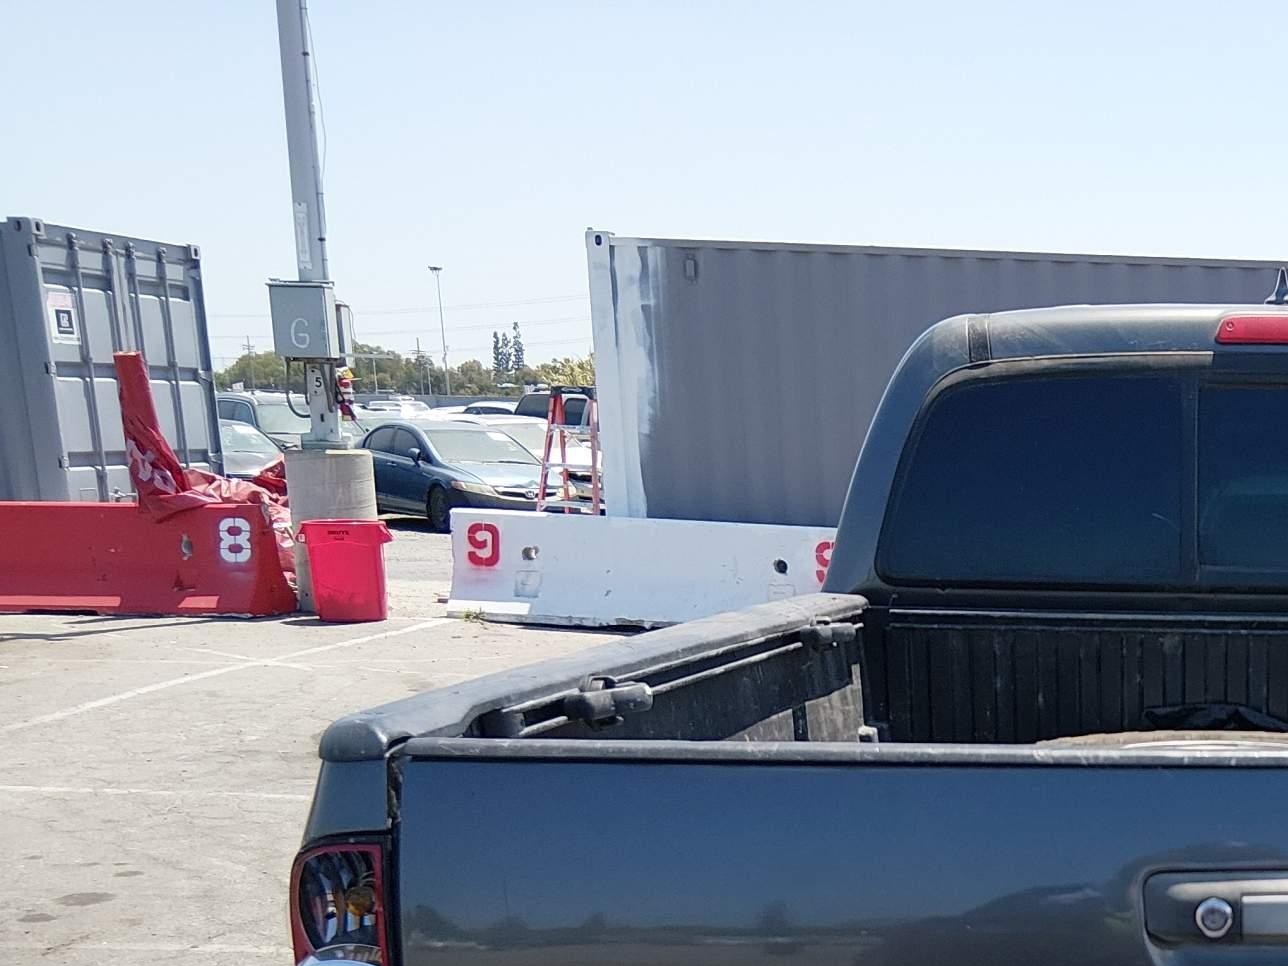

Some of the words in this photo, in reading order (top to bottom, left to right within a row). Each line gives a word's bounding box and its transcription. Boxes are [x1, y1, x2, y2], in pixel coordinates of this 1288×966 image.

[290, 318, 310, 349] G
[314, 376, 322, 388] 5
[219, 517, 252, 563] 8
[467, 522, 500, 568] 9
